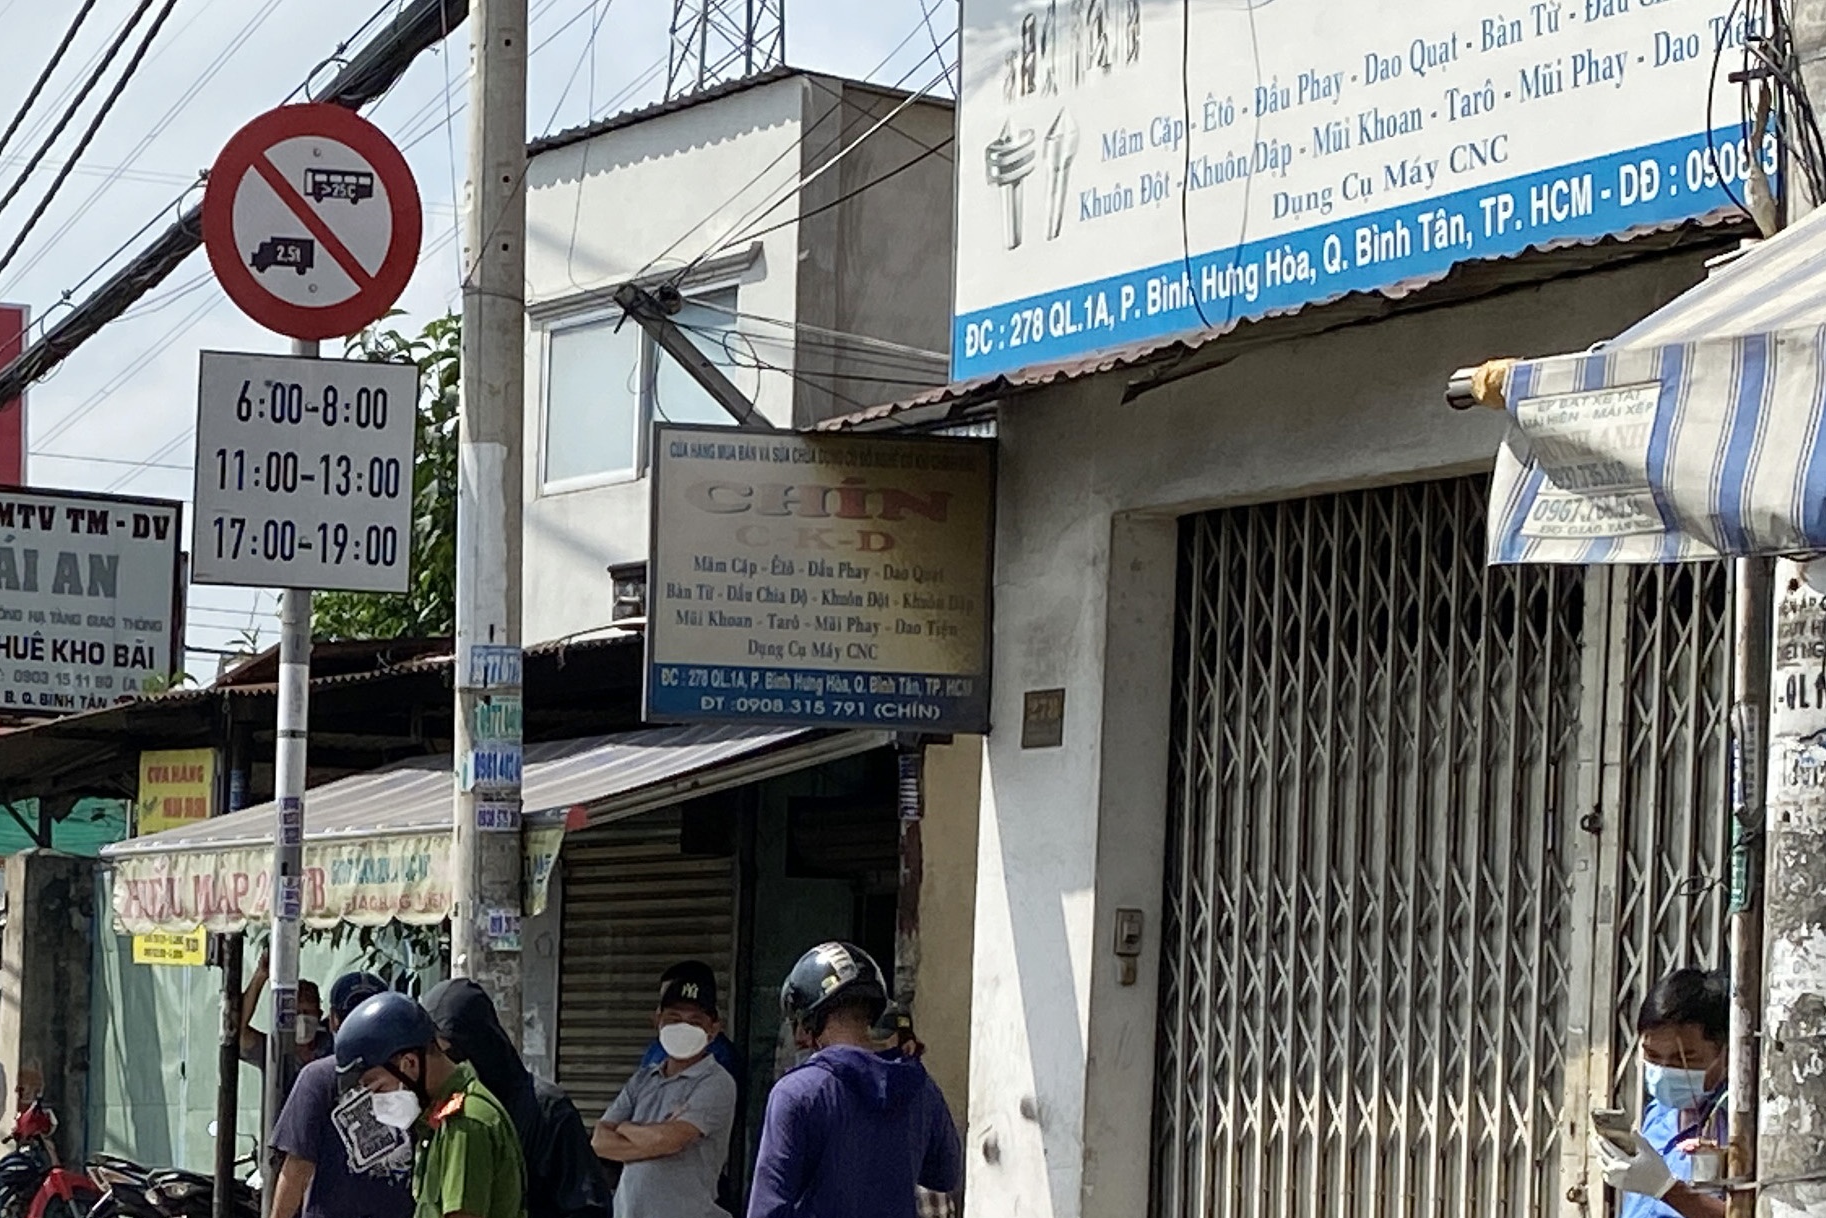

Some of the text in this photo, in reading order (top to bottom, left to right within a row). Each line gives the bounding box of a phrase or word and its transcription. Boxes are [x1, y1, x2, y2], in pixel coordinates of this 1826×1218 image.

[1102, 128, 1144, 162] Mâm
[1297, 68, 1346, 105] Phay
[1365, 53, 1402, 86] Dao
[1410, 32, 1459, 77] Quạt
[1481, 14, 1523, 52] Bàn
[1079, 182, 1134, 222] Khuôn
[1189, 150, 1250, 191] Khuôn
[1312, 117, 1351, 158] Mũi
[1358, 107, 1424, 146] Khoan
[1444, 78, 1496, 122] Tarô
[1518, 58, 1563, 103] Mũi
[1571, 48, 1628, 89] Phay
[1654, 30, 1700, 67] Dao
[1273, 134, 1509, 221] Dụng Cụ Máy CNC
[1009, 306, 1044, 347] 278
[1049, 291, 1115, 339] QL.1A,
[1120, 285, 1142, 322] P.
[1147, 271, 1195, 318] Bình
[1201, 261, 1260, 302] Hưng
[1265, 243, 1317, 287] Hòa,
[1323, 233, 1349, 275] Q.
[1355, 218, 1412, 266] Bình
[1417, 207, 1474, 251] Tân,
[1479, 193, 1523, 238] TP.
[1530, 173, 1594, 227] HCM
[215, 448, 400, 499] 11:00-13:00
[66, 507, 109, 535] TM
[132, 513, 170, 540] DV
[212, 516, 398, 567] 17:00-19:00
[51, 551, 120, 599] AN
[51, 638, 105, 665] KHO
[113, 638, 155, 669] BÃI
[832, 701, 865, 716] 791
